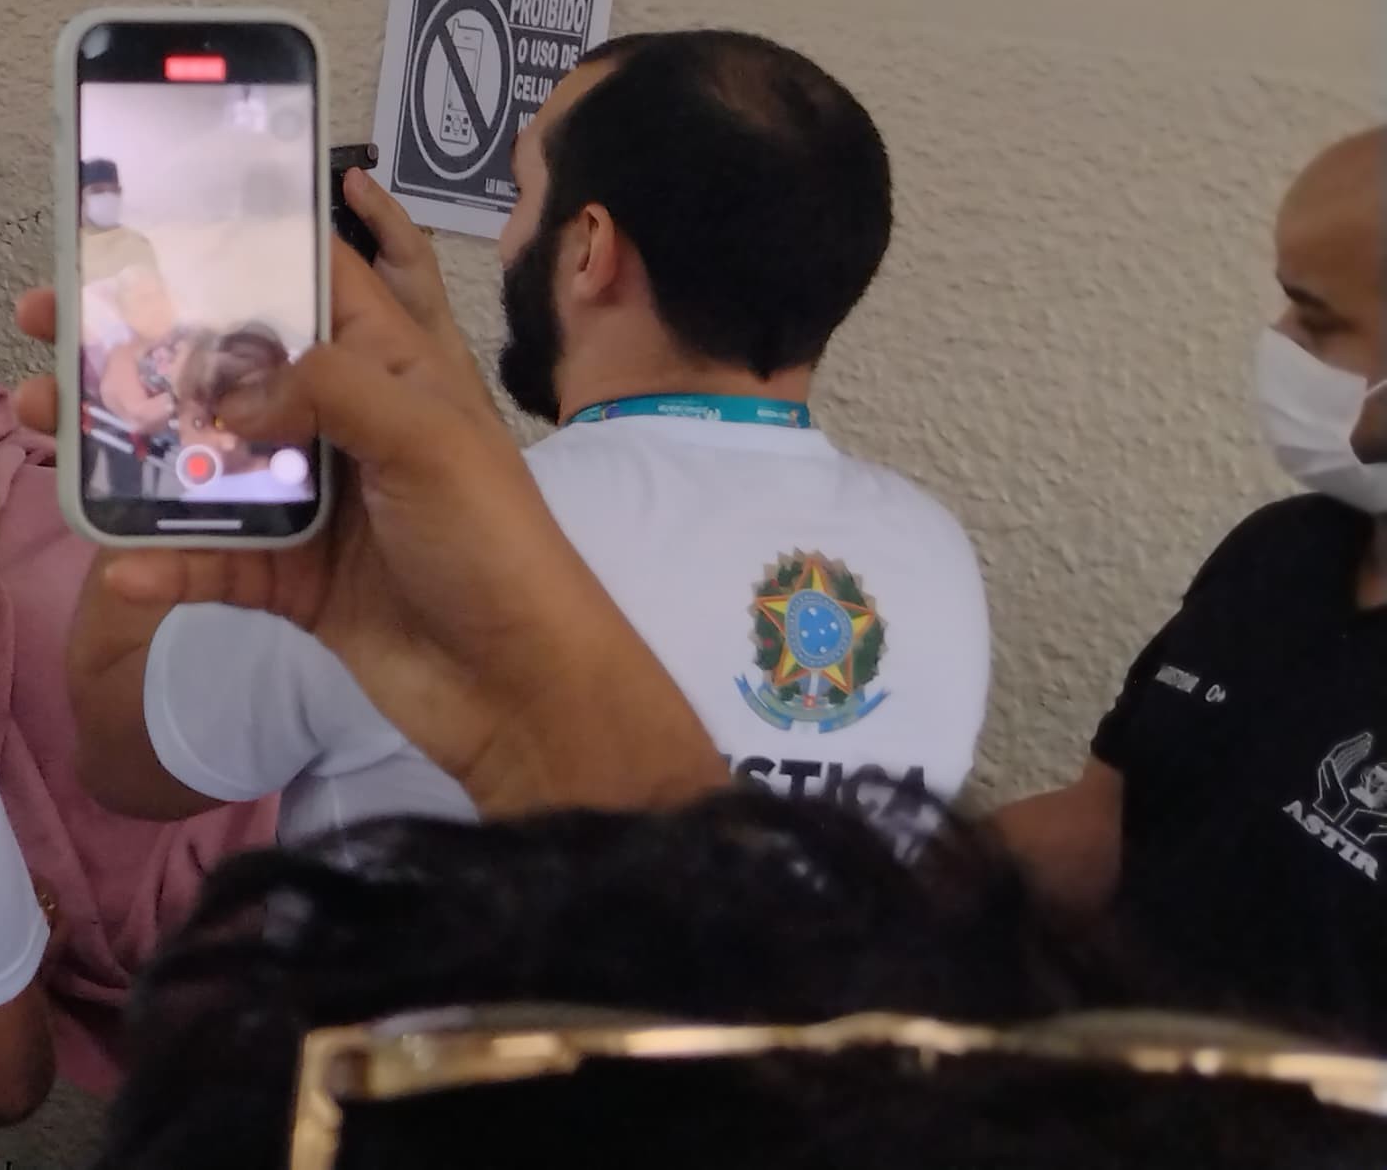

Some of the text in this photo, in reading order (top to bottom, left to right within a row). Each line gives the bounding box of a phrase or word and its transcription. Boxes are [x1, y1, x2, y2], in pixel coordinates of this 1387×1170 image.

[517, 37, 579, 70] O USO DE
